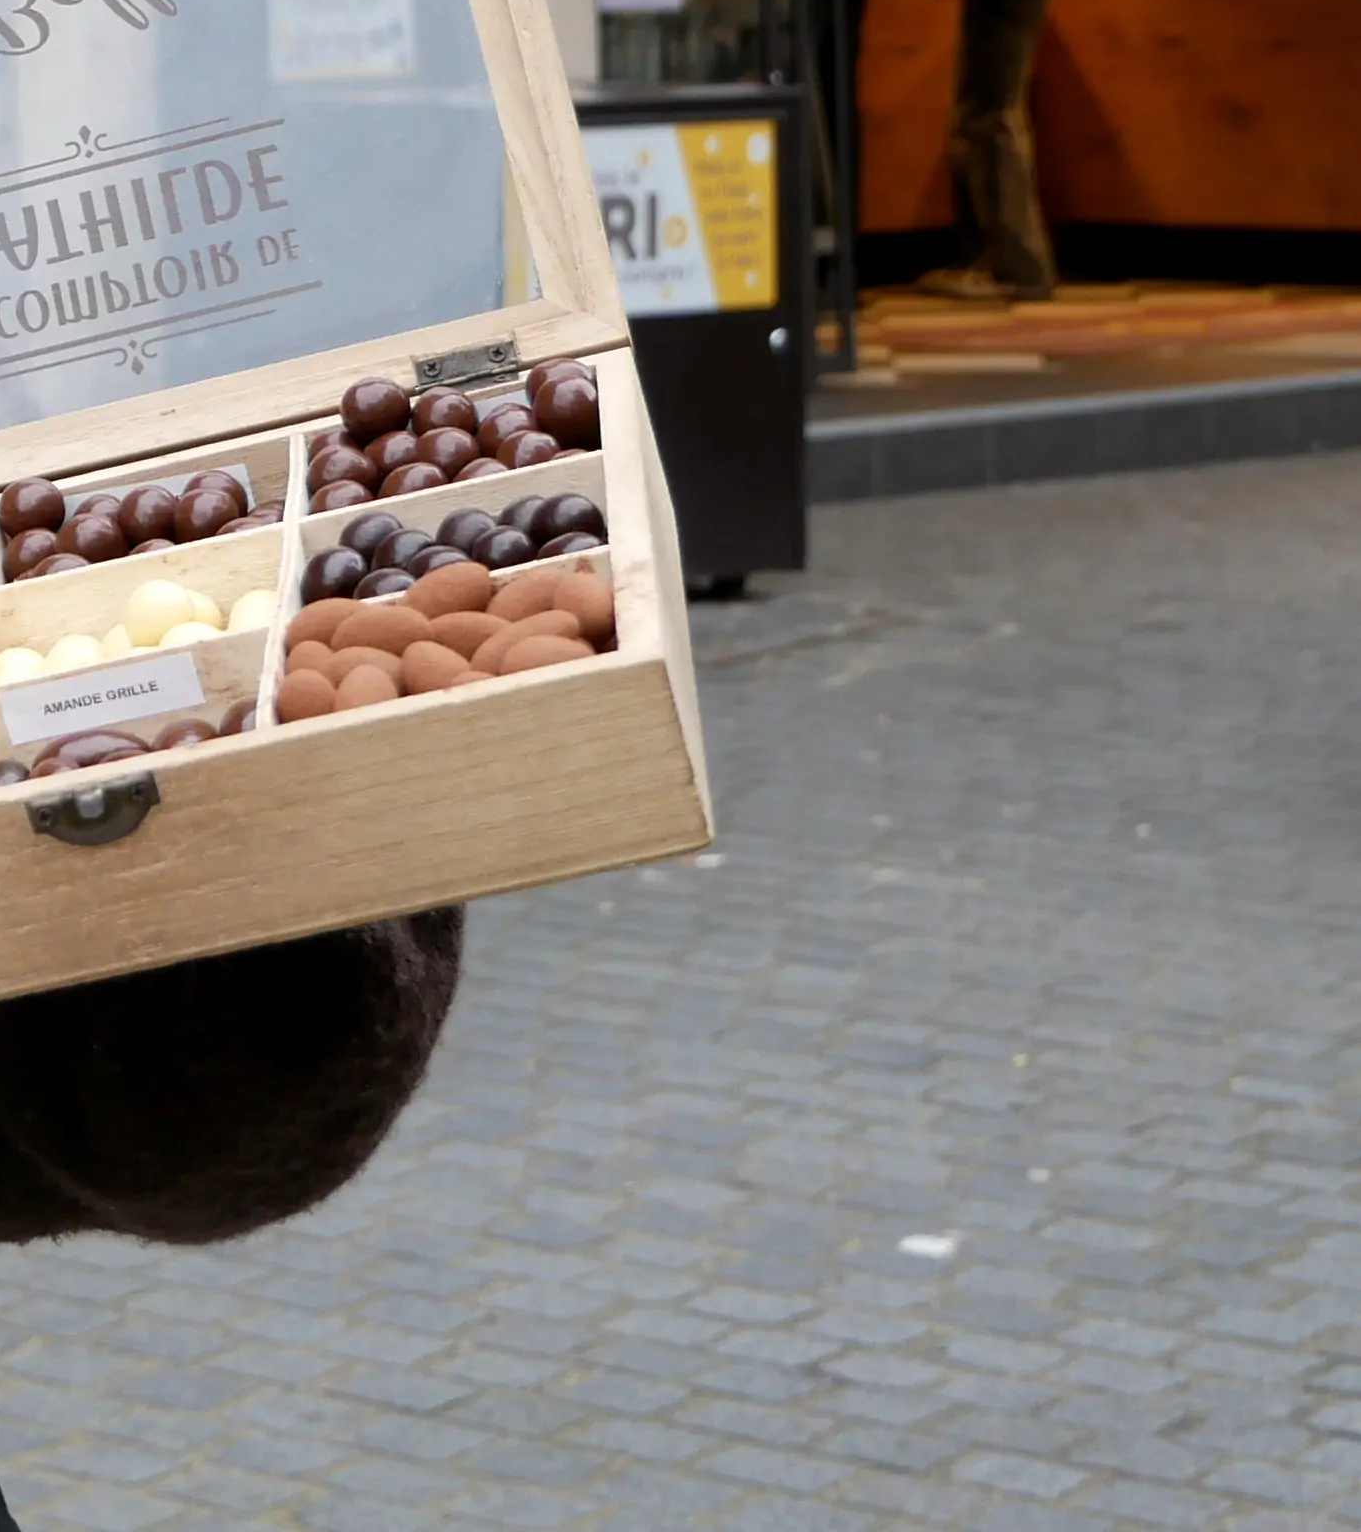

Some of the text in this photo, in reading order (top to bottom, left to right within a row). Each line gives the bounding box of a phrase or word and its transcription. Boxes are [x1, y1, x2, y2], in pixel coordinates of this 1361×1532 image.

[602, 190, 659, 260] RI
[42, 679, 160, 716] AMANDE GRILLE
